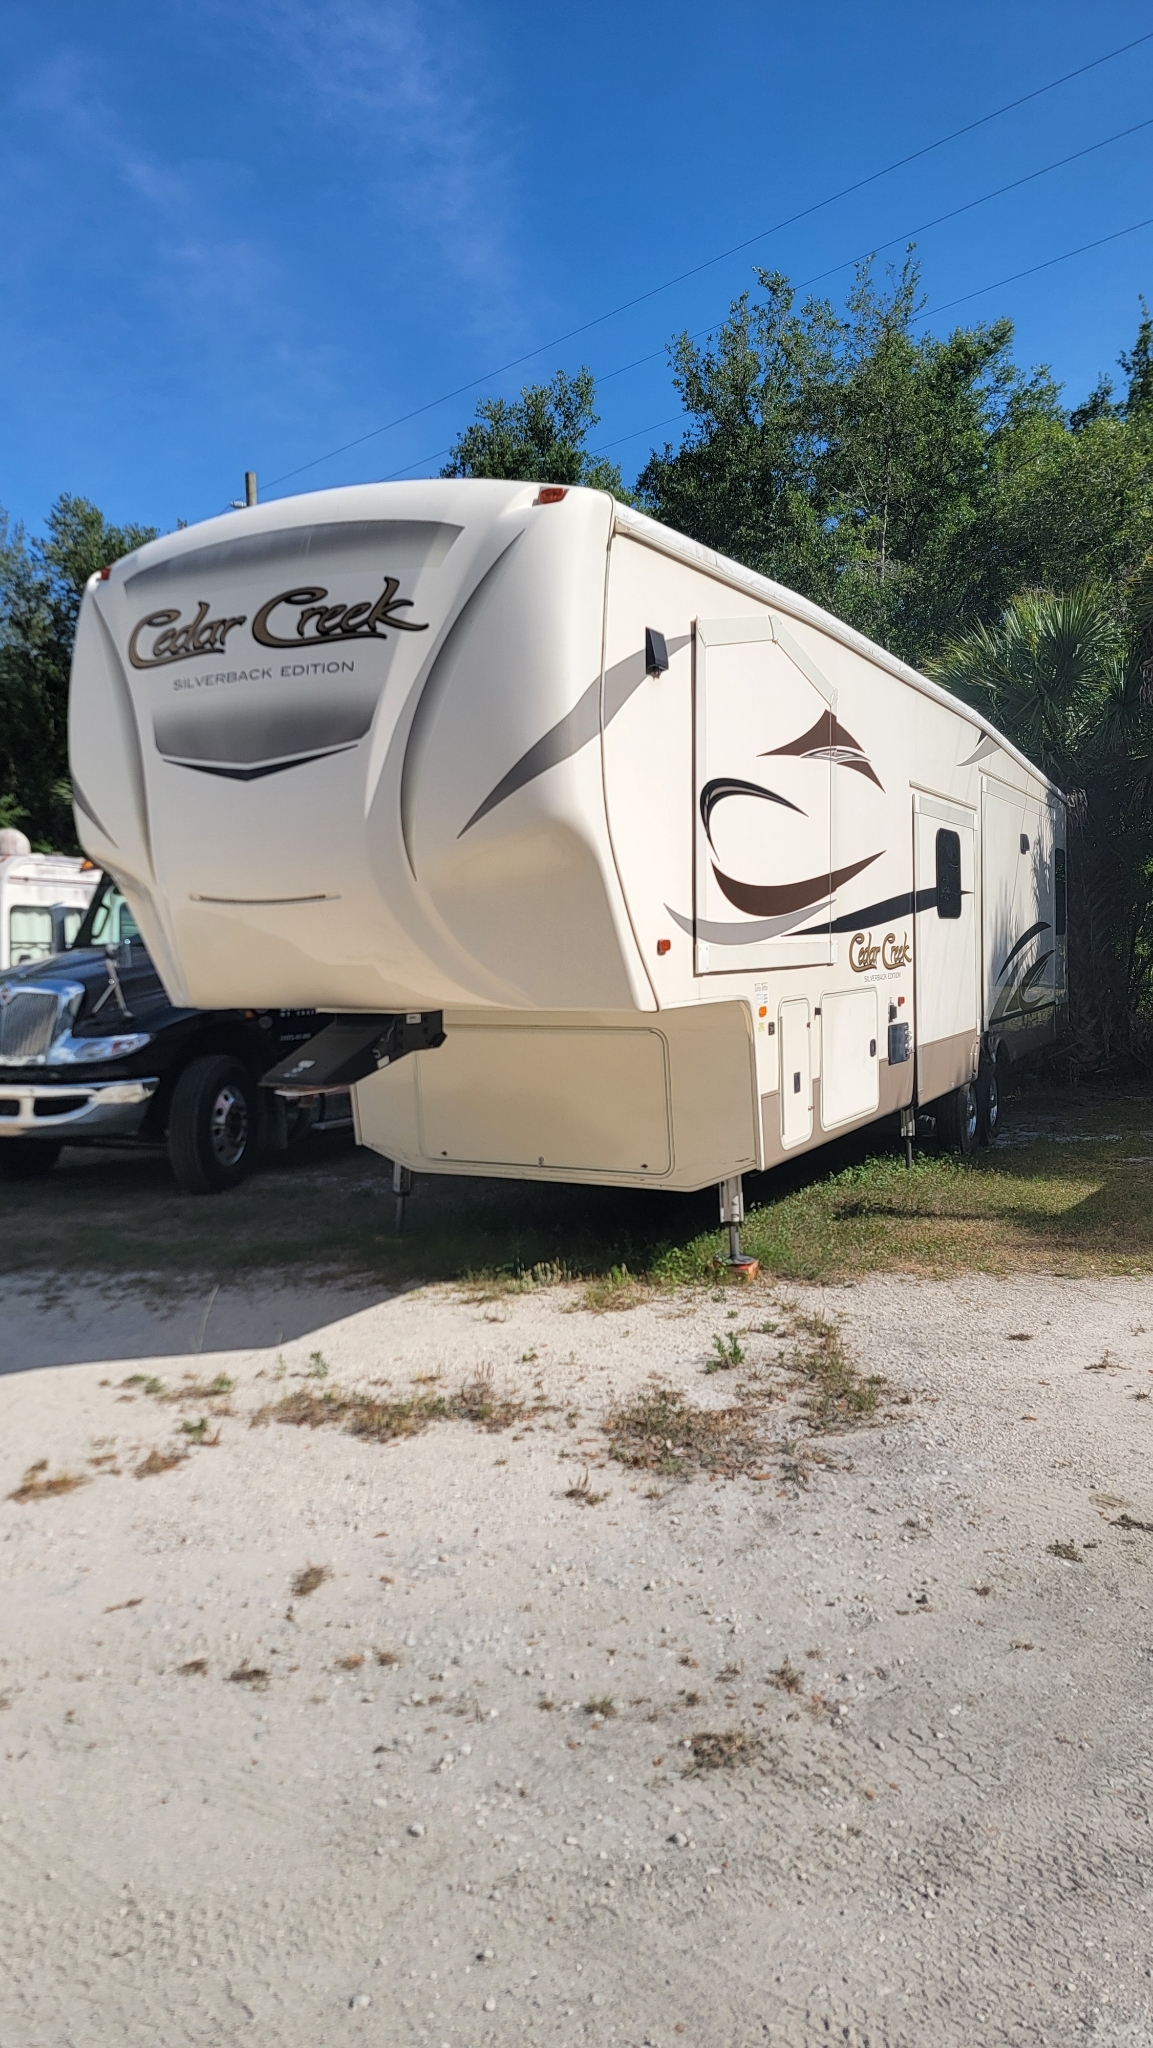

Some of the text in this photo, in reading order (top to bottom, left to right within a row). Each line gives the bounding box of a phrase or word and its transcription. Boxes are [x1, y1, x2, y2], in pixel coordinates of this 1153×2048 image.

[129, 576, 429, 670] Cedar Creek
[173, 661, 355, 691] SILVERBACK EDITION
[849, 931, 912, 972] Cedar Creek
